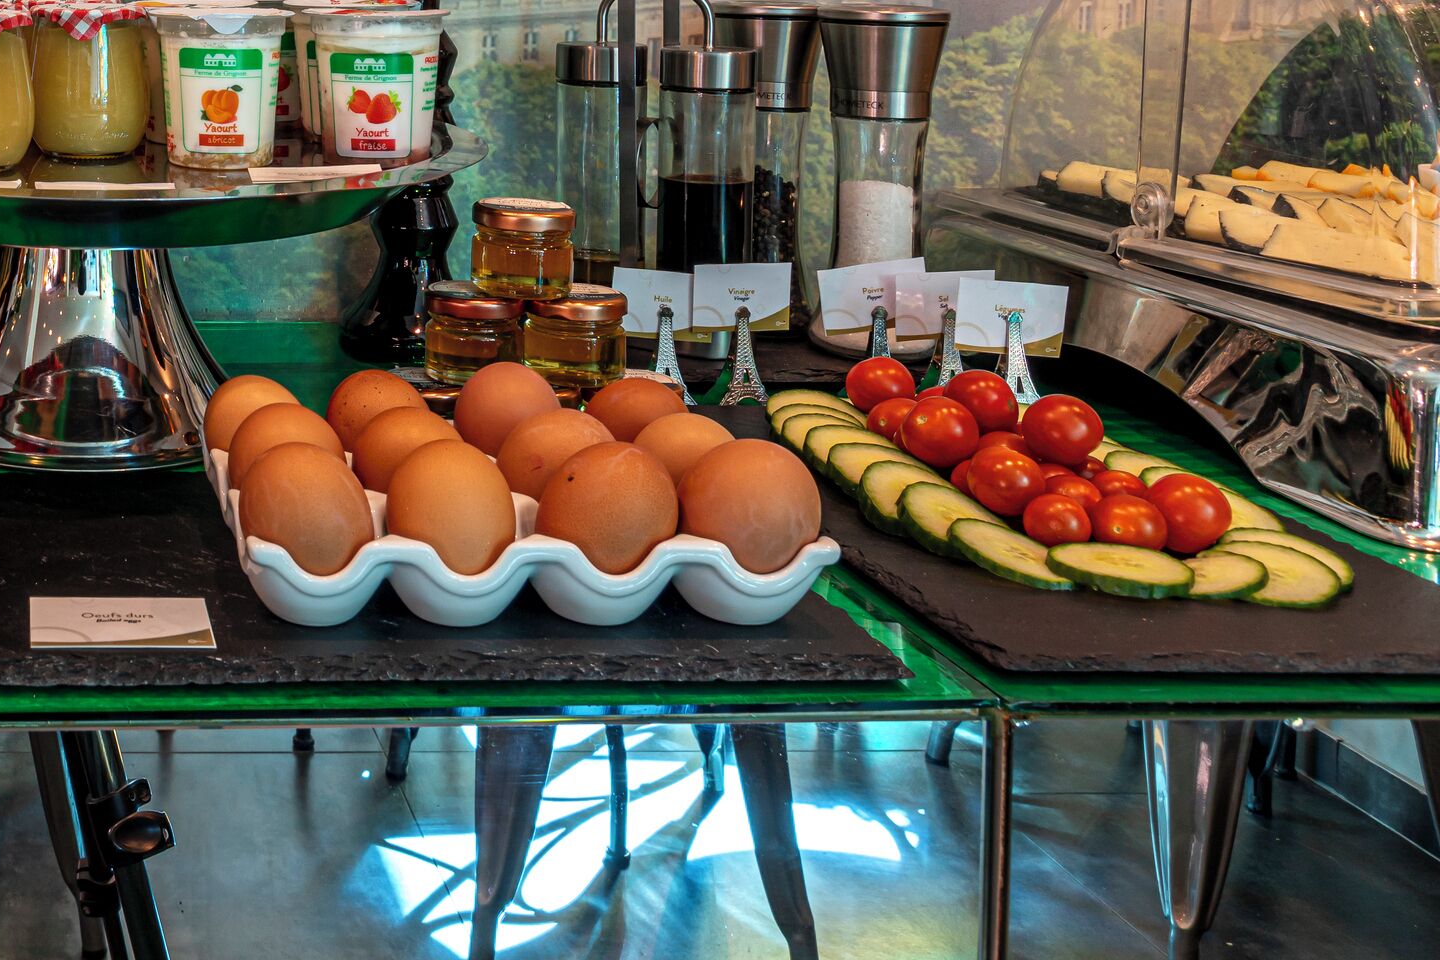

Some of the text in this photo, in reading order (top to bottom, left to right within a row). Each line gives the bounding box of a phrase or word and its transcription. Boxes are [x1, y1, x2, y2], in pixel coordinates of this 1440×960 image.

[194, 69, 213, 77] Ferme
[223, 69, 247, 78] Grignon
[344, 74, 362, 82] Ferme
[373, 74, 398, 83] Grignon
[203, 122, 238, 133] Yaourt
[355, 127, 390, 138] Yaourt
[207, 136, 236, 145] abricot
[358, 141, 388, 152] fraise
[727, 287, 756, 297] Vinaigre
[862, 286, 885, 295] Poivre
[653, 295, 673, 304] Huile
[938, 295, 949, 304] Sel
[81, 611, 154, 619] Oeufs durs
